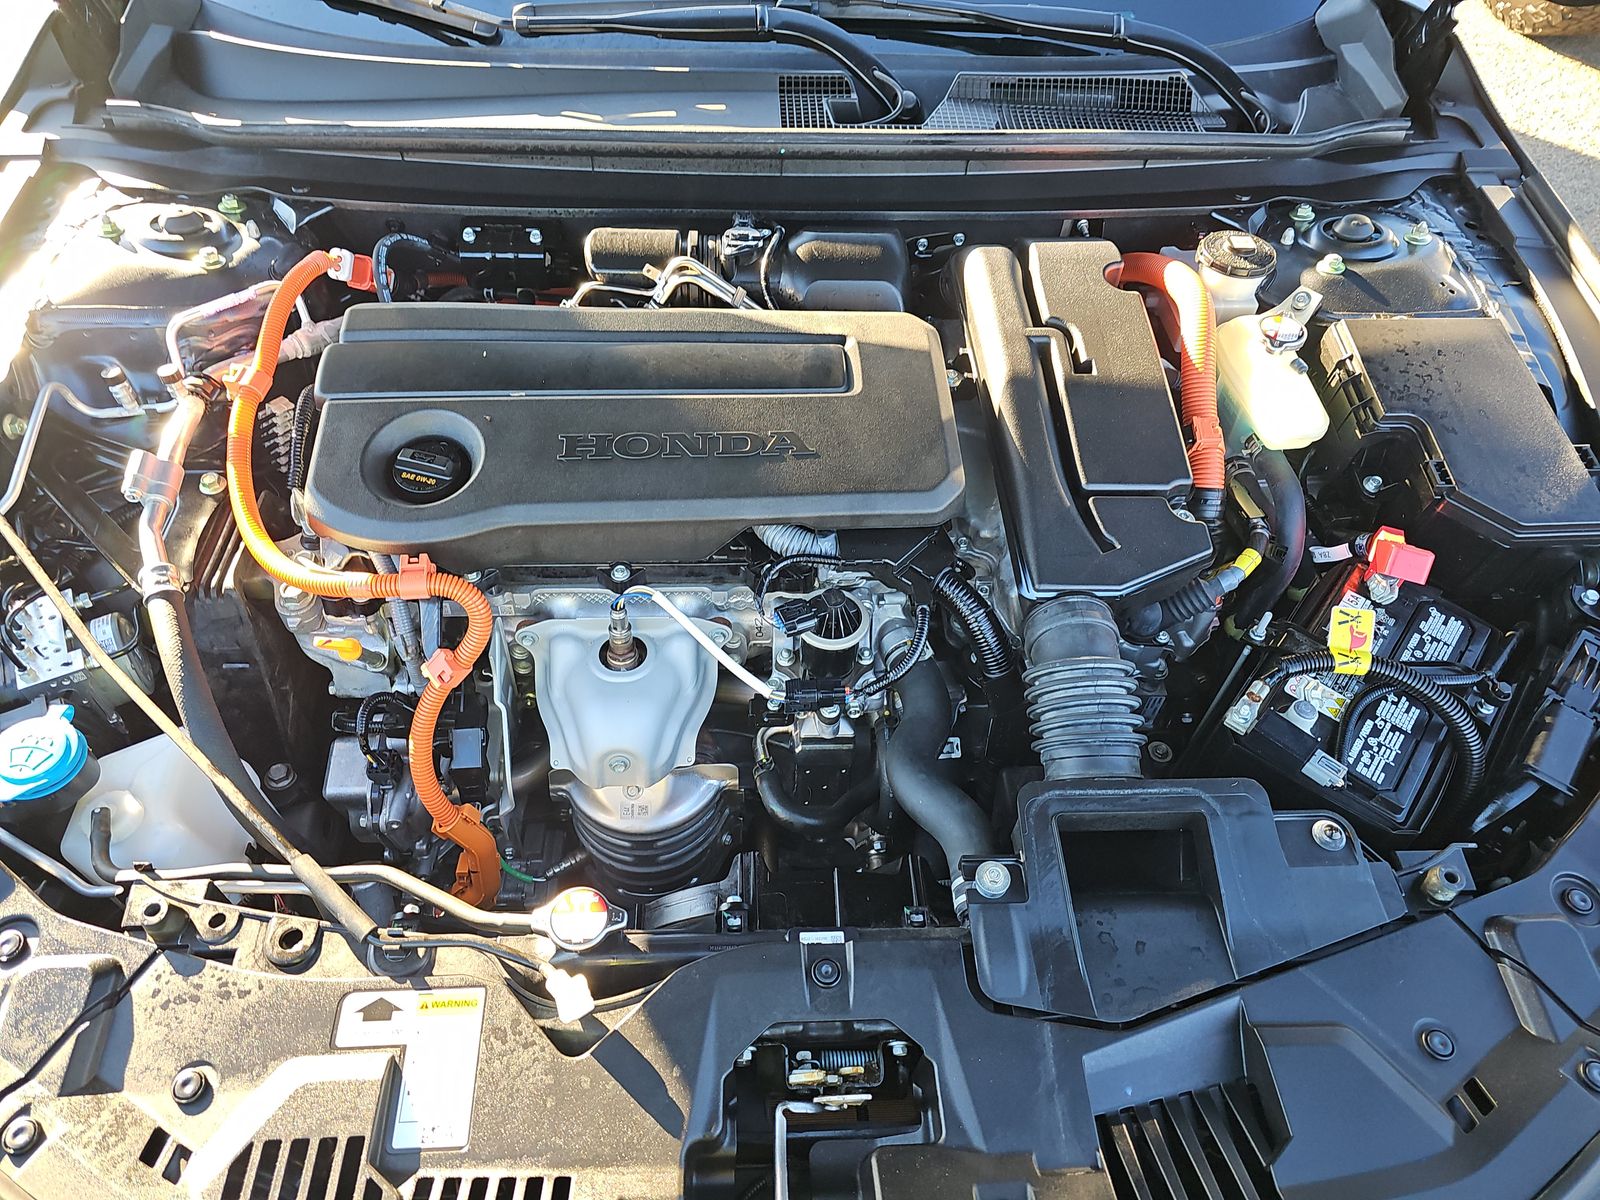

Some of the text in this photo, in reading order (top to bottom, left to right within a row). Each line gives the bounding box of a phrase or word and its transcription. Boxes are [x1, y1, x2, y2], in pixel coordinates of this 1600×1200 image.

[557, 431, 817, 460] HONDA
[401, 472, 416, 481] SAE
[755, 618, 764, 637] 042
[431, 999, 478, 1009] WARNING
